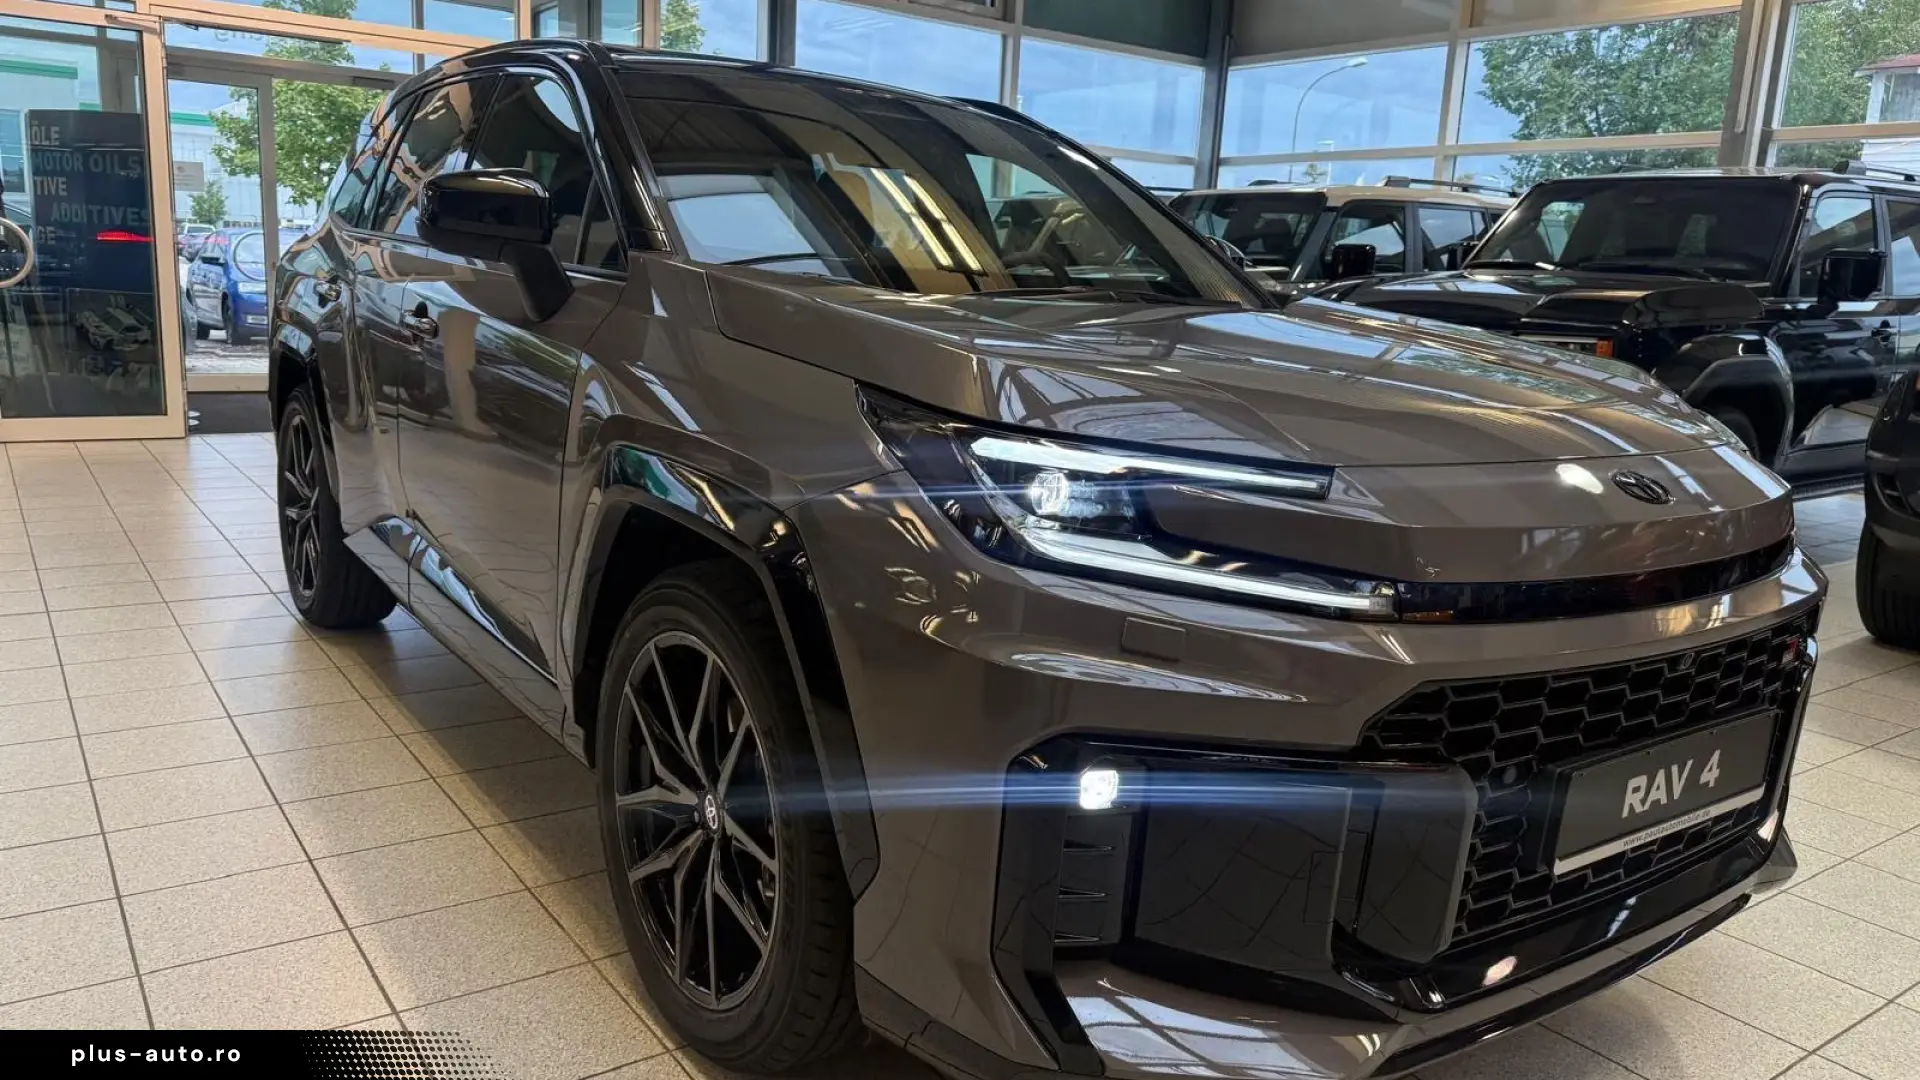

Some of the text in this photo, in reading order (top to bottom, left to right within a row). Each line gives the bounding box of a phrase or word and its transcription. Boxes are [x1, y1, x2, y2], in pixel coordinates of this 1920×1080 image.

[89, 153, 142, 175] OILS
[1621, 749, 1721, 819] RAV 4
